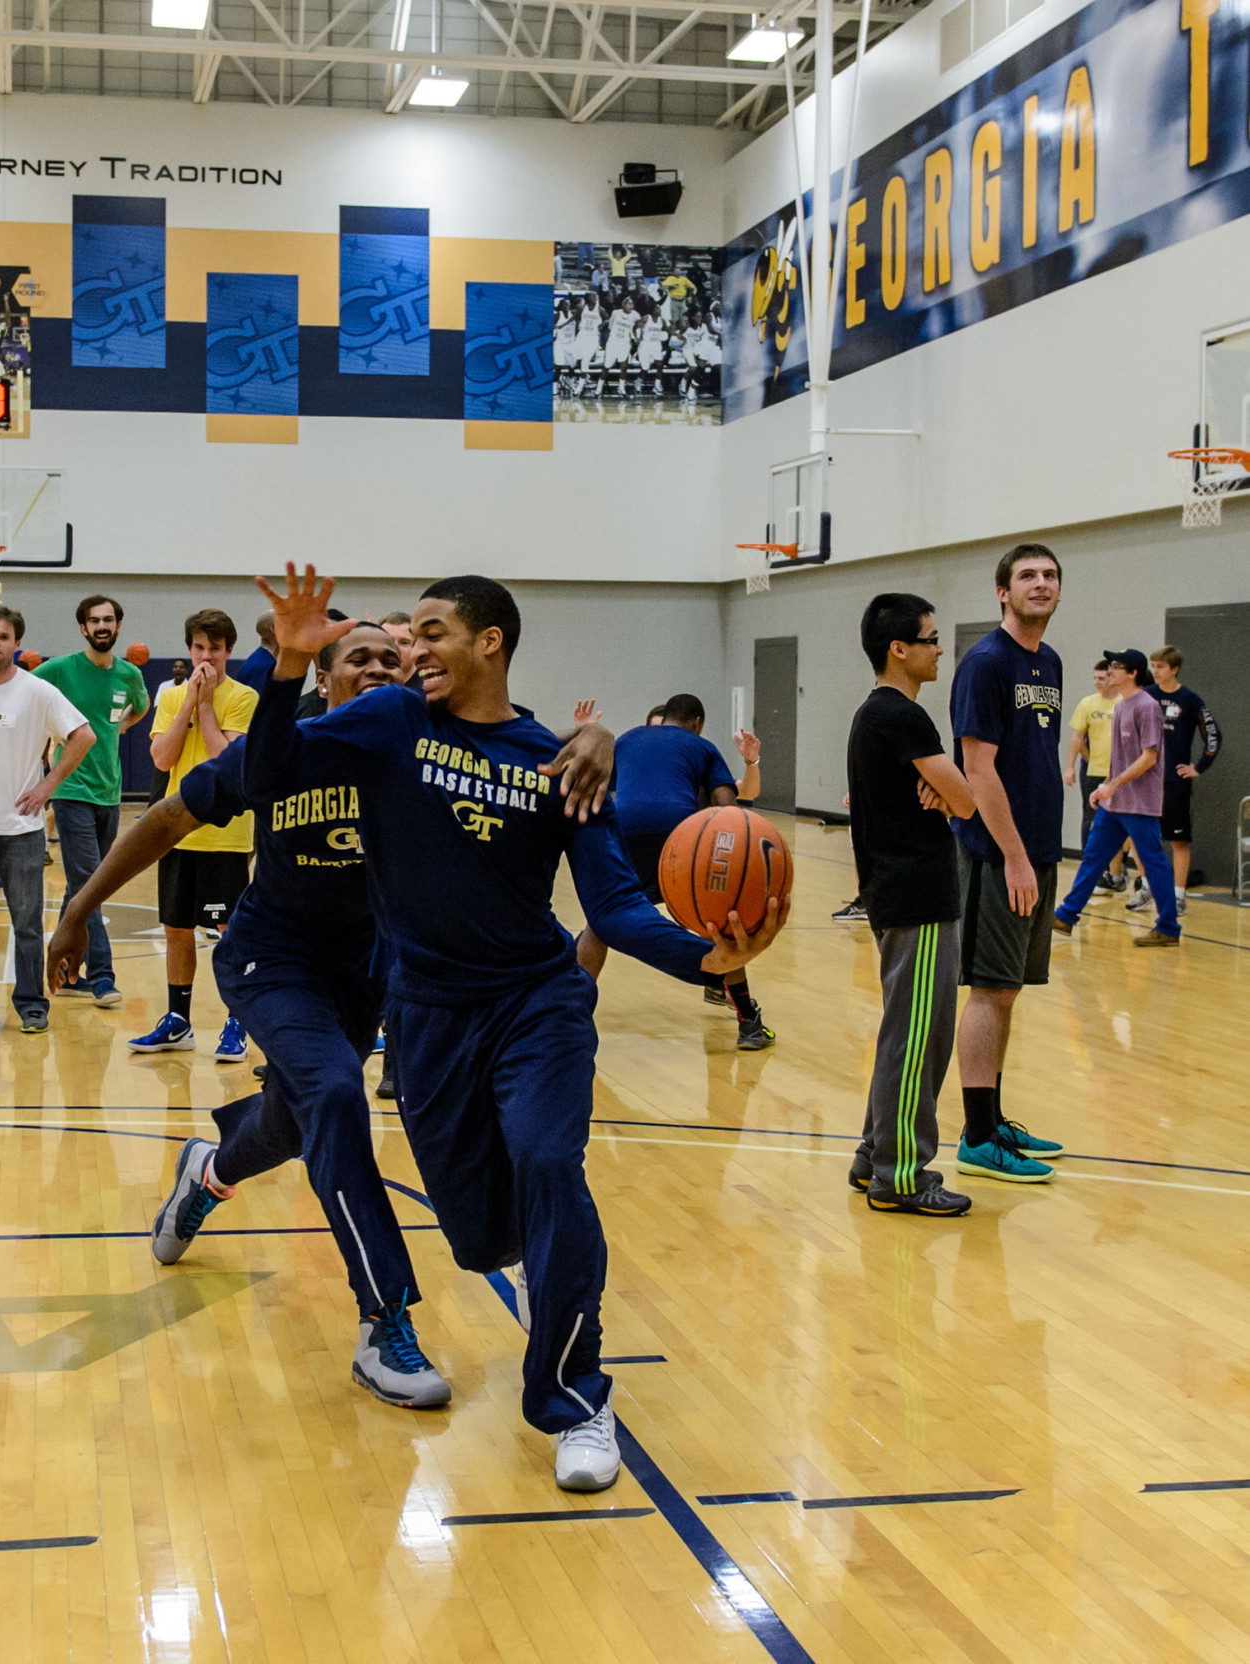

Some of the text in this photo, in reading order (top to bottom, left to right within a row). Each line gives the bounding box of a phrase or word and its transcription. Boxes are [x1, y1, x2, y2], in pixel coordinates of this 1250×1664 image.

[100, 157, 282, 186] TRADITION
[811, 66, 1096, 338] EORGIA
[415, 738, 550, 795] GEORGIA TECH
[422, 764, 537, 812] BASKETBALL
[272, 786, 360, 832] GEORGIA
[452, 800, 504, 841] GT
